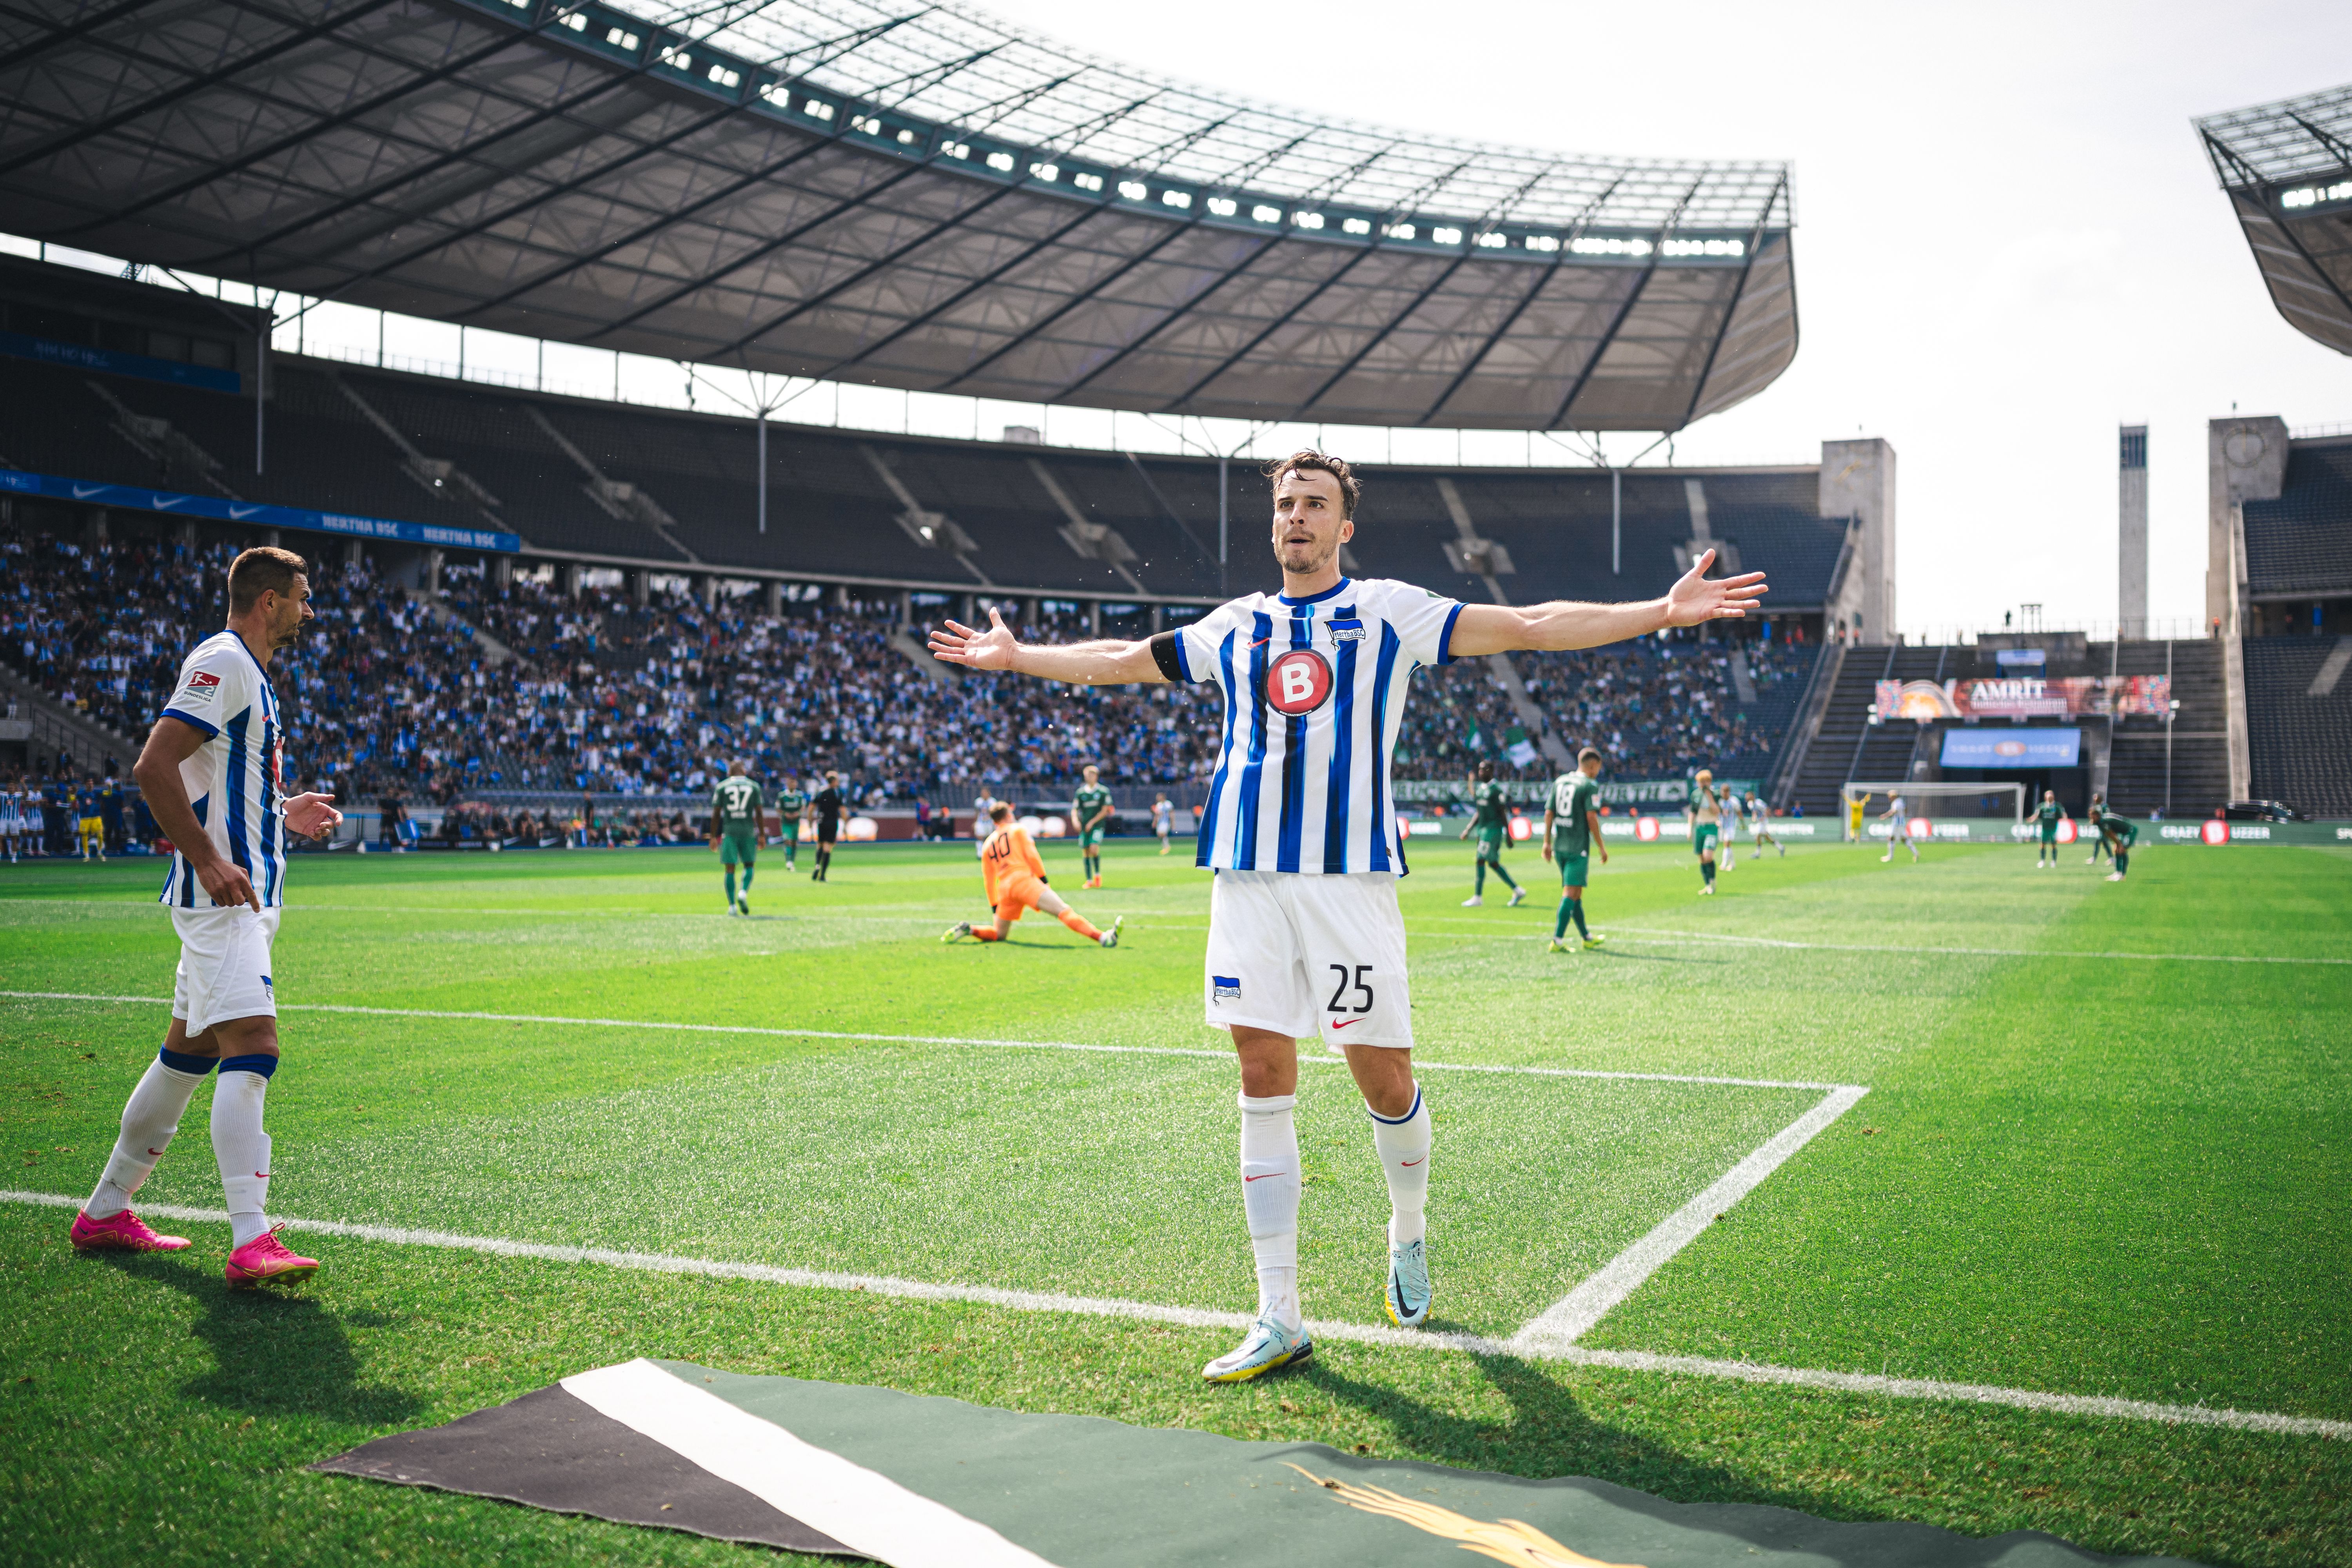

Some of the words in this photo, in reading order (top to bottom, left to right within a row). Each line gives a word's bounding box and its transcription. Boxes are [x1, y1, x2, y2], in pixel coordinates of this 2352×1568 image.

[322, 515, 373, 534] HERTHA
[423, 526, 472, 545] HERTHA
[204, 686, 214, 696] 2
[1281, 662, 1314, 704] B
[184, 691, 211, 702] BUNDESLIGA
[724, 786, 753, 810] 37
[1555, 784, 1575, 817] 18
[2160, 826, 2200, 838] CRAZY
[988, 833, 1010, 862] 40
[1327, 964, 1373, 1013] 25
